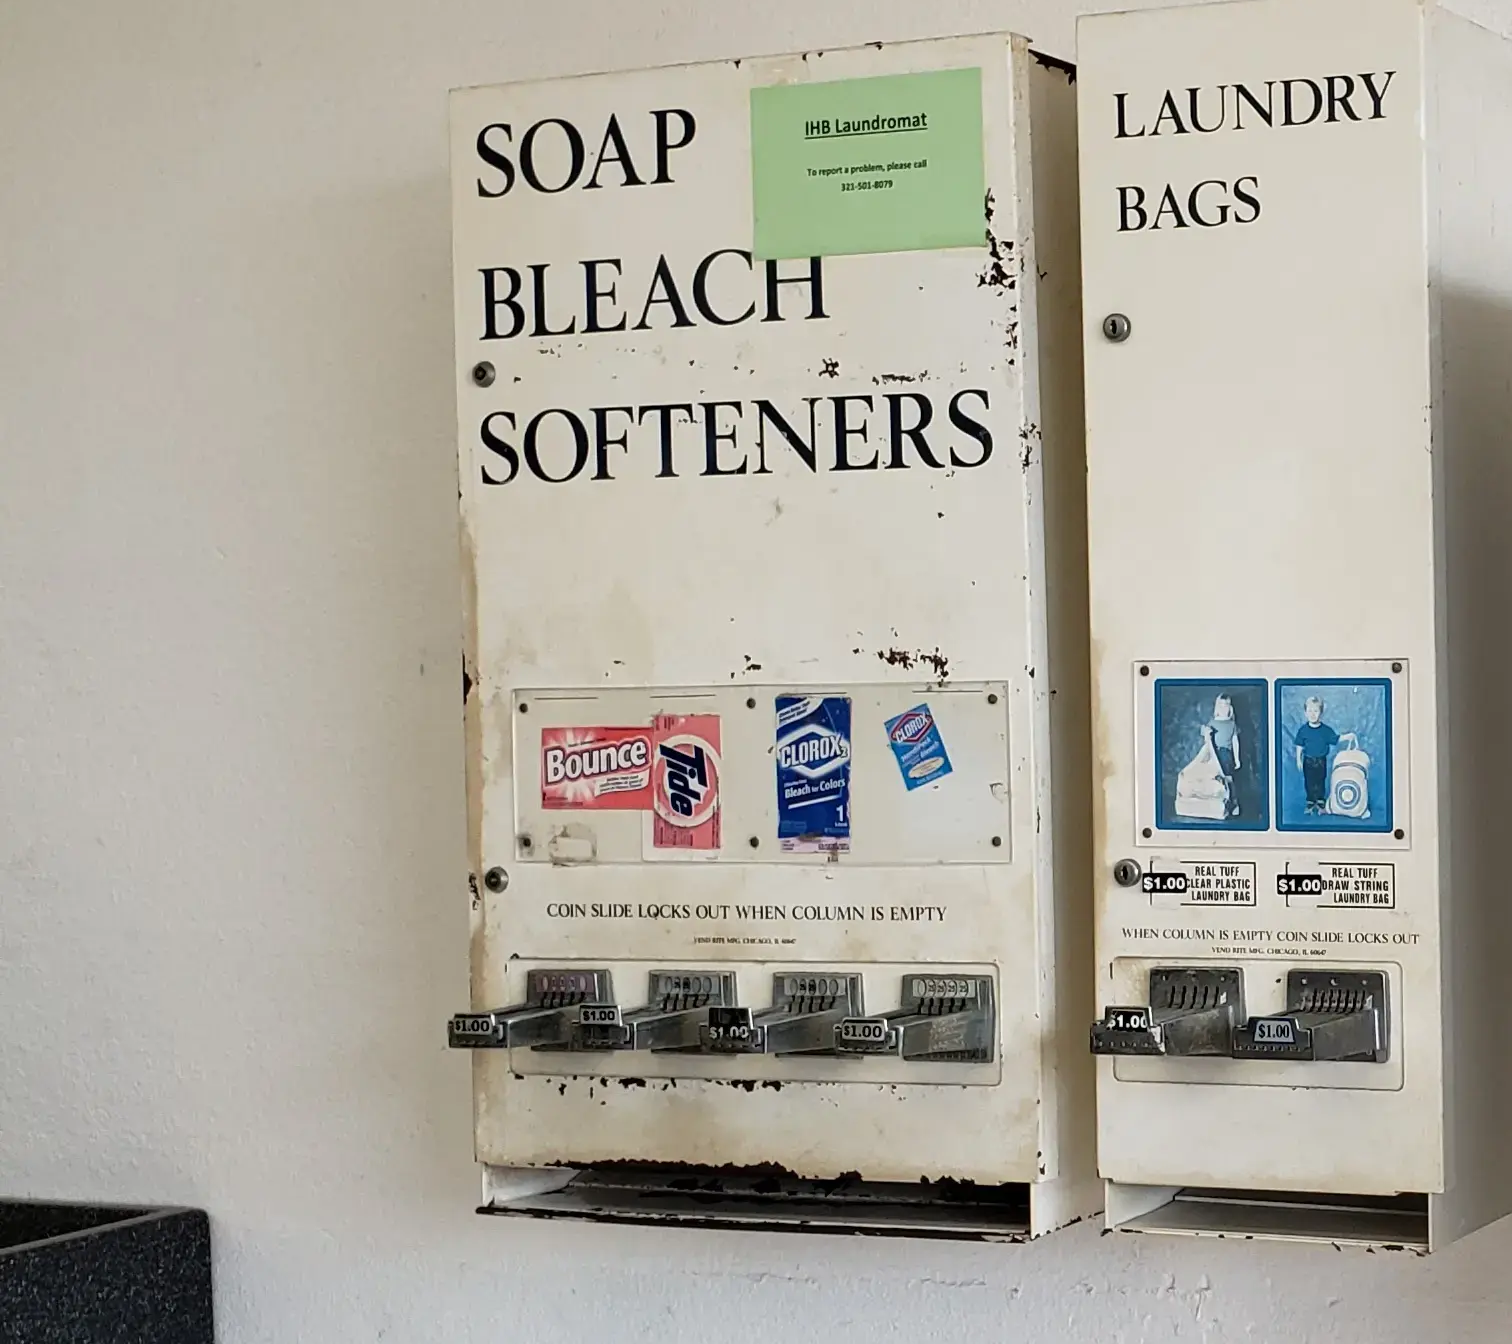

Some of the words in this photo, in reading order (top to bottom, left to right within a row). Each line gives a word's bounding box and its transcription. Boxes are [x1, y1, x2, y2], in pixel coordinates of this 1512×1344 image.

[1113, 71, 1397, 139] LAUNDRY
[805, 120, 830, 136] IHB
[836, 112, 927, 133] Laundromat
[476, 108, 697, 198] SOAP
[807, 168, 817, 176] To
[819, 167, 842, 177] report
[851, 163, 885, 175] problem,
[887, 161, 912, 172] please
[914, 159, 927, 169] call
[841, 180, 893, 192] 321-501-8079
[1115, 176, 1261, 232] BAGS
[478, 248, 830, 340] BLEACH
[479, 389, 994, 485] SOFTENERS
[895, 712, 928, 743] CLOROX
[546, 741, 646, 783] Bounce
[659, 744, 708, 816] Tide
[785, 784, 811, 799] Bleach
[820, 778, 846, 791] Colors
[836, 805, 843, 822] 1
[1195, 866, 1216, 876] REAL
[1220, 866, 1240, 877] TUFF
[1332, 868, 1354, 878] REAL
[1357, 868, 1378, 878] TUFF
[1143, 876, 1186, 891] $1.00
[1186, 878, 1211, 889] CLEAR
[1215, 878, 1251, 889] PLASTIC
[1278, 878, 1321, 893] $1.00
[1322, 880, 1349, 890] DRAW
[1354, 880, 1389, 891] STRING
[1192, 891, 1230, 901] LAUNDRY
[1233, 891, 1251, 901] BAG
[1333, 892, 1370, 904] LAUNDRY
[1373, 893, 1389, 904] BAG
[547, 903, 586, 918] COIN
[591, 904, 633, 918] SLIDE
[638, 904, 691, 920] LOCKS
[695, 905, 730, 919] OUT
[735, 905, 786, 920] WHEN
[792, 905, 864, 921] COLUMN
[871, 906, 884, 921] IS
[890, 906, 947, 921] EMPTY
[1122, 927, 1159, 939] WHEN
[1162, 928, 1215, 940] COLUMN
[1219, 929, 1229, 940] IS
[1233, 929, 1273, 942] EMPTY
[1276, 931, 1308, 942] COIN
[1311, 931, 1344, 943] SLIDE
[1348, 932, 1389, 944] LOCKS
[1392, 933, 1420, 944] OUT
[582, 1010, 615, 1022] $1.00
[1106, 1013, 1148, 1030] $1.00
[455, 1020, 490, 1032] $1.00
[843, 1025, 883, 1038] $1.00
[1258, 1024, 1290, 1039] $1.00
